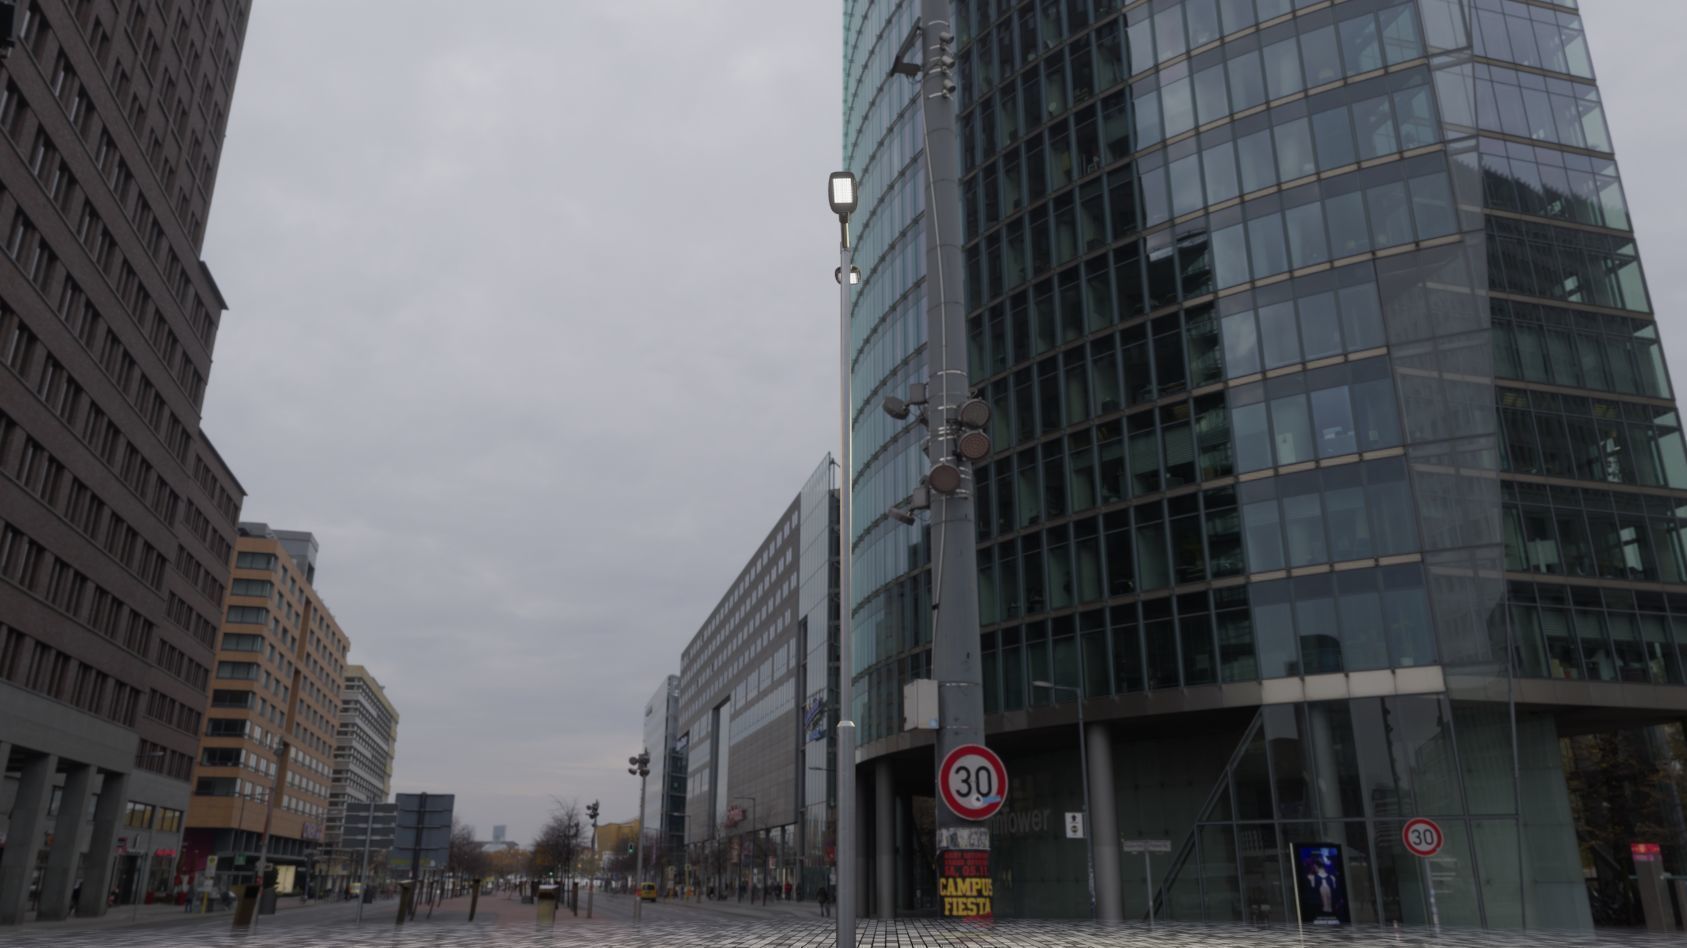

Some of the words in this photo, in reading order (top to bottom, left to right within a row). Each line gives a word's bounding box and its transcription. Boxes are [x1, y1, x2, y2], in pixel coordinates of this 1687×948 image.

[954, 765, 992, 798] 30
[1410, 829, 1435, 846] 30
[939, 878, 993, 897] CAMPUS
[943, 897, 992, 916] FIESTA
